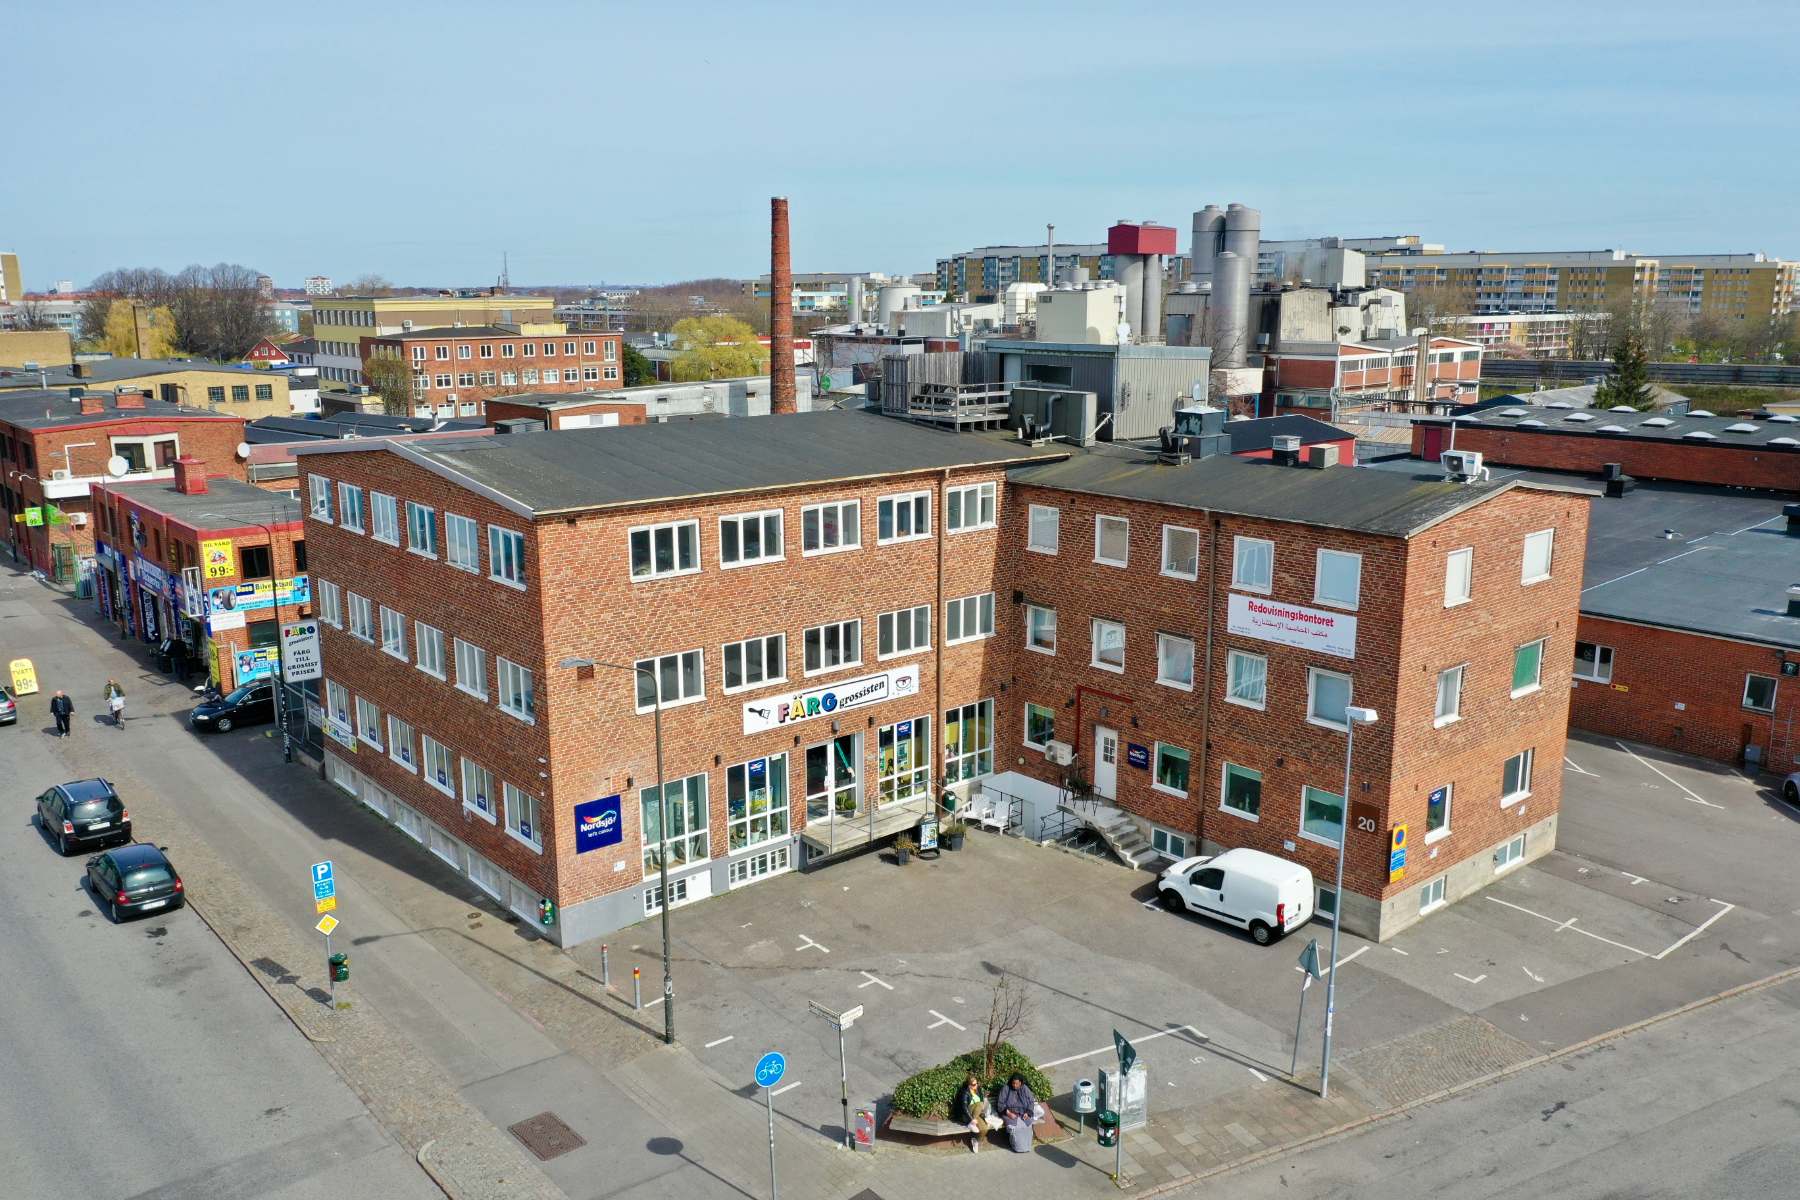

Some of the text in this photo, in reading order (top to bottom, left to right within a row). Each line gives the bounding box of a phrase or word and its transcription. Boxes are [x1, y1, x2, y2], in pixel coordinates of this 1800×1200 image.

[1248, 600, 1334, 627] Redovisningskontoret
[287, 661, 318, 671] GROSSIST
[291, 668, 316, 677] PRISER
[839, 680, 886, 710] grossisten
[777, 692, 839, 723] FÄRG
[580, 816, 613, 832] Nordsjö
[1357, 816, 1376, 833] 20
[316, 864, 329, 880] P
